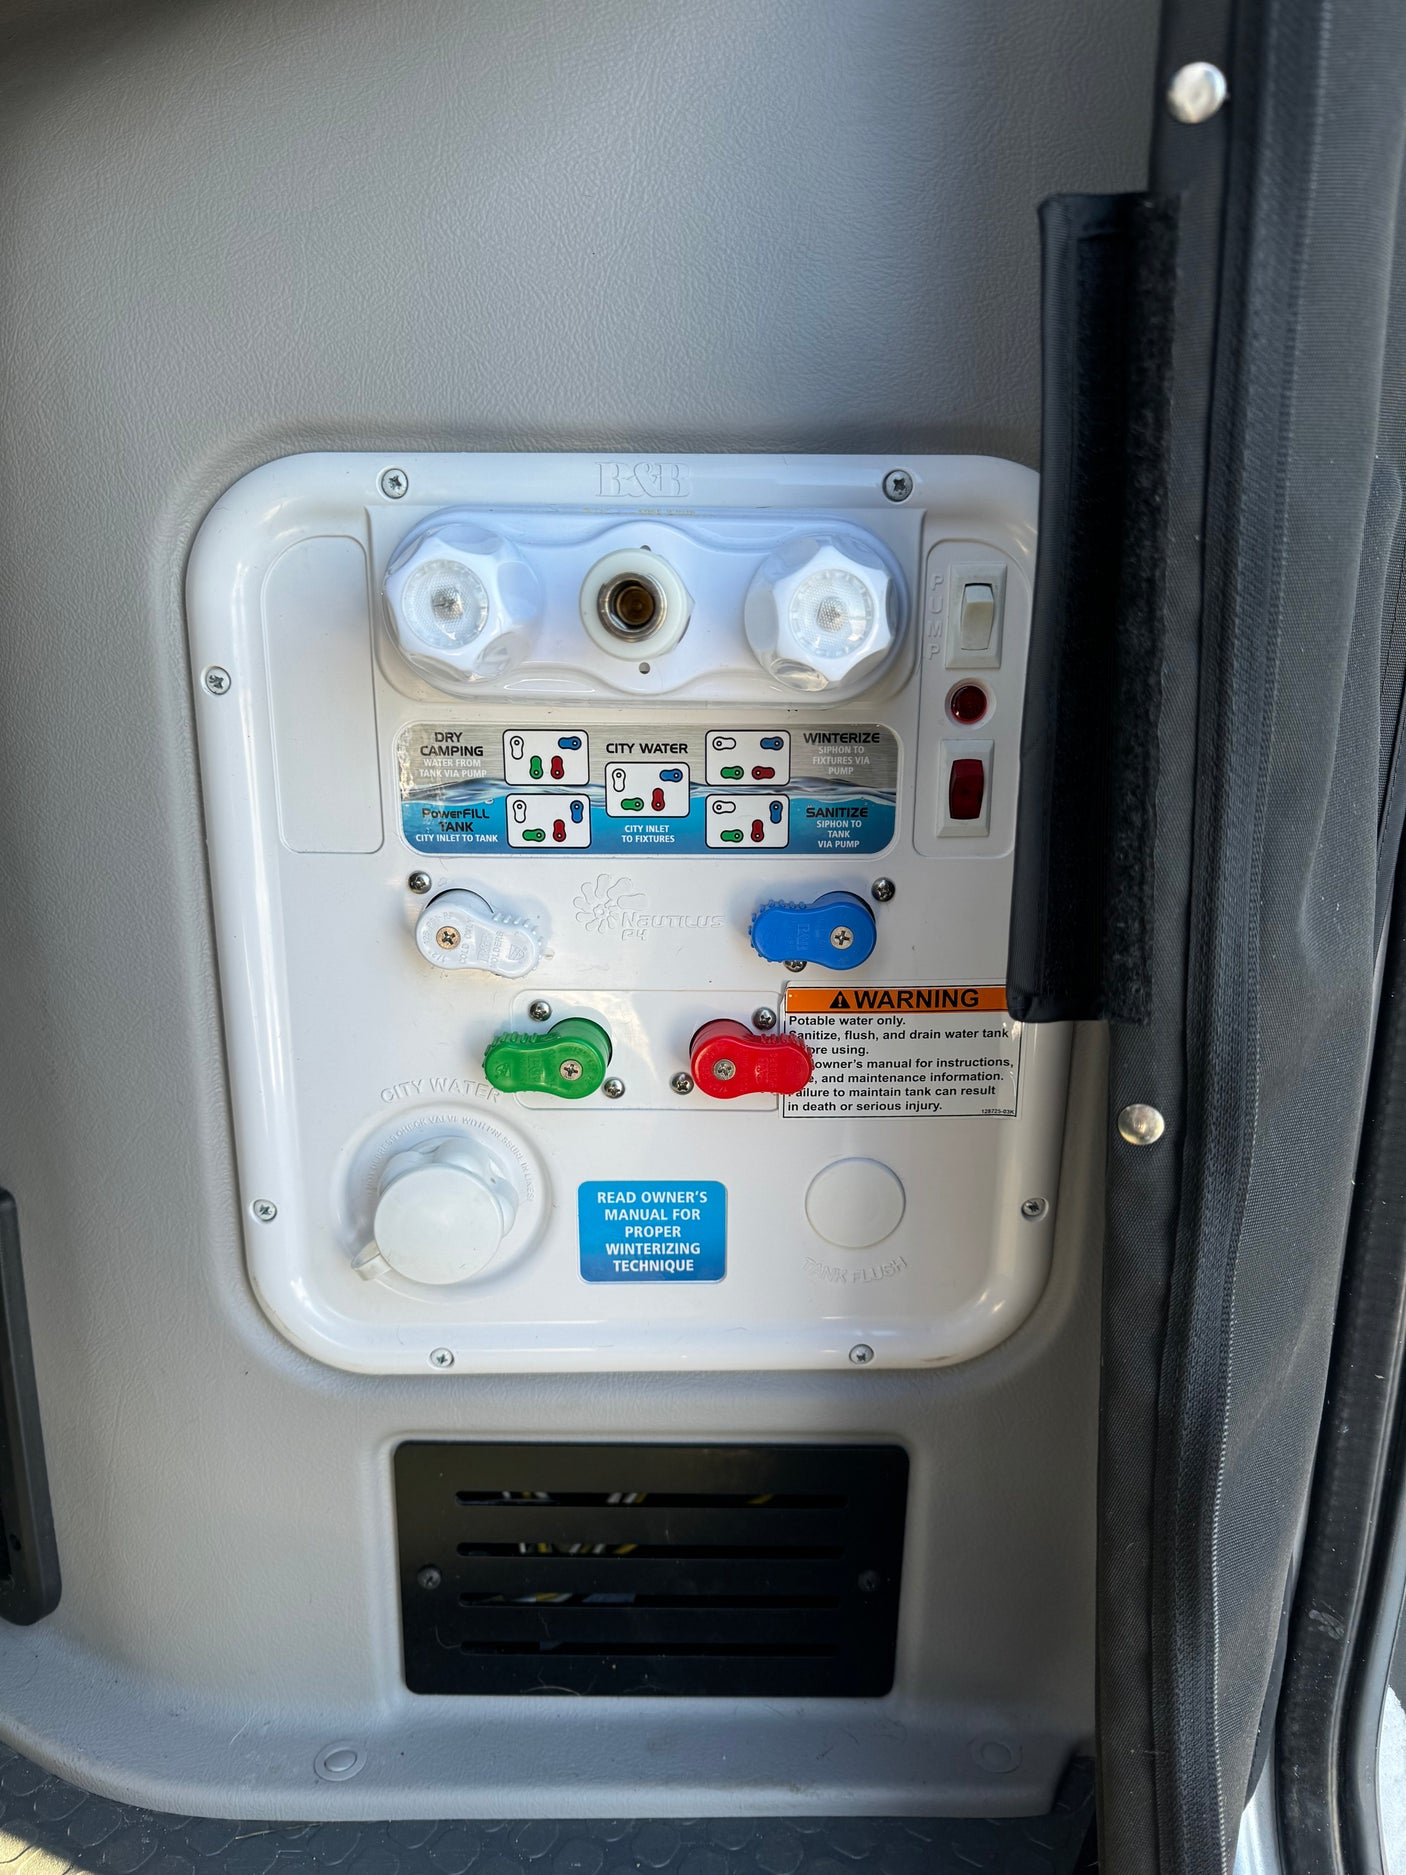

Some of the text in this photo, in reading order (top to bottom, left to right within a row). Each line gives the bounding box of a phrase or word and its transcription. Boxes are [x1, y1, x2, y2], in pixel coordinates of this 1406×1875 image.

[595, 462, 690, 497] B&B
[927, 574, 944, 661] PUMP
[434, 732, 463, 743] DRY
[803, 733, 881, 744] WINTERIZE
[420, 746, 484, 757] CAMPING
[606, 743, 688, 754] CITY WATER
[818, 745, 865, 754] SIPHON TO
[423, 758, 481, 767] WATER FROM
[812, 756, 870, 765] FIXTURES VIA
[419, 769, 487, 778] TANK VIA PUMP
[828, 766, 854, 775] PUMP
[806, 807, 868, 818] SANITIZE
[438, 821, 474, 833] TANK
[625, 825, 670, 833] CITY INLET
[816, 820, 862, 829] SIPHON TO
[415, 834, 498, 842] CITY INLET TO TANK
[621, 834, 675, 843] TO FIXTURES
[827, 830, 851, 838] TANK
[817, 840, 860, 848] VIA PUMP
[854, 989, 979, 1009] WARNING
[789, 1016, 906, 1028] Potable water only.
[845, 1029, 879, 1041] flush,
[883, 1029, 906, 1040] and
[909, 1029, 941, 1040] drain
[945, 1030, 979, 1039] water
[982, 1028, 1009, 1038] tank
[832, 1045, 869, 1057] using.
[867, 1059, 912, 1069] manual
[915, 1058, 934, 1068] for
[936, 1058, 1014, 1069] instructions,
[821, 1073, 844, 1083] and
[848, 1073, 926, 1083] maintenance
[930, 1072, 1004, 1082] information.
[380, 1077, 500, 1103] CITY WATER
[789, 1086, 996, 1098] ailure to maintain tank can result
[788, 1101, 943, 1113] in death or serious injury.
[597, 1190, 708, 1203] READ OWNER'S
[604, 1208, 701, 1221] MANUAL FOR
[625, 1225, 681, 1238] PROPER
[605, 1243, 701, 1255] WINTERIZING
[613, 1260, 694, 1273] TECHNIQUE
[853, 1256, 908, 1283] FLUSH
